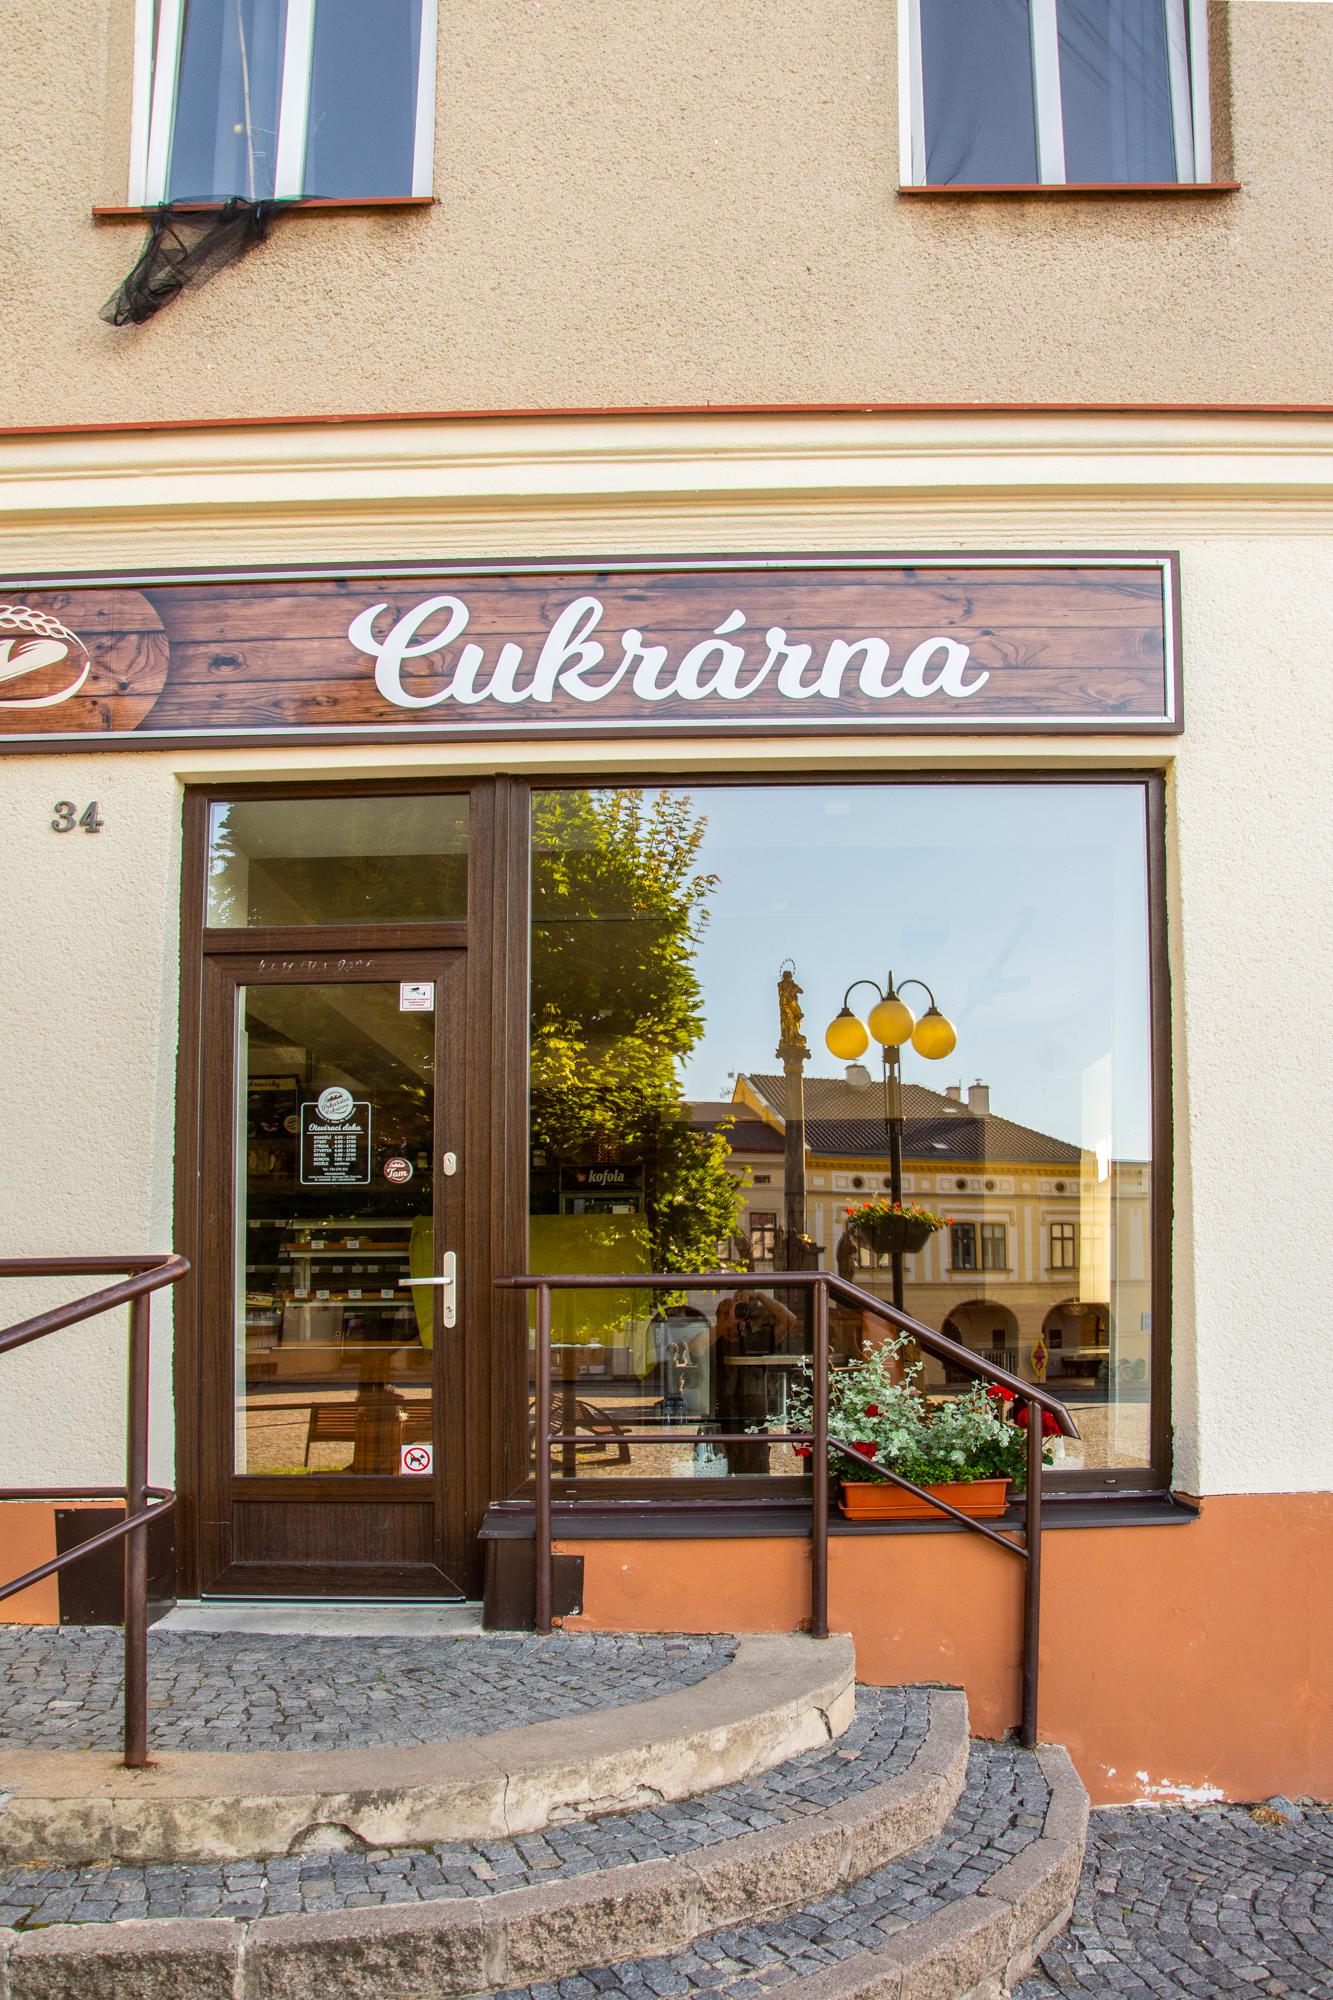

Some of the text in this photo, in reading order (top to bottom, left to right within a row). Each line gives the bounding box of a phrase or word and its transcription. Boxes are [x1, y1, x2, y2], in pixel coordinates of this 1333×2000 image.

[348, 595, 990, 708] Cukrárna
[51, 800, 104, 833] 34
[342, 1123, 362, 1131] doba
[386, 1168, 408, 1178] Tam
[588, 1169, 625, 1186] kofola
